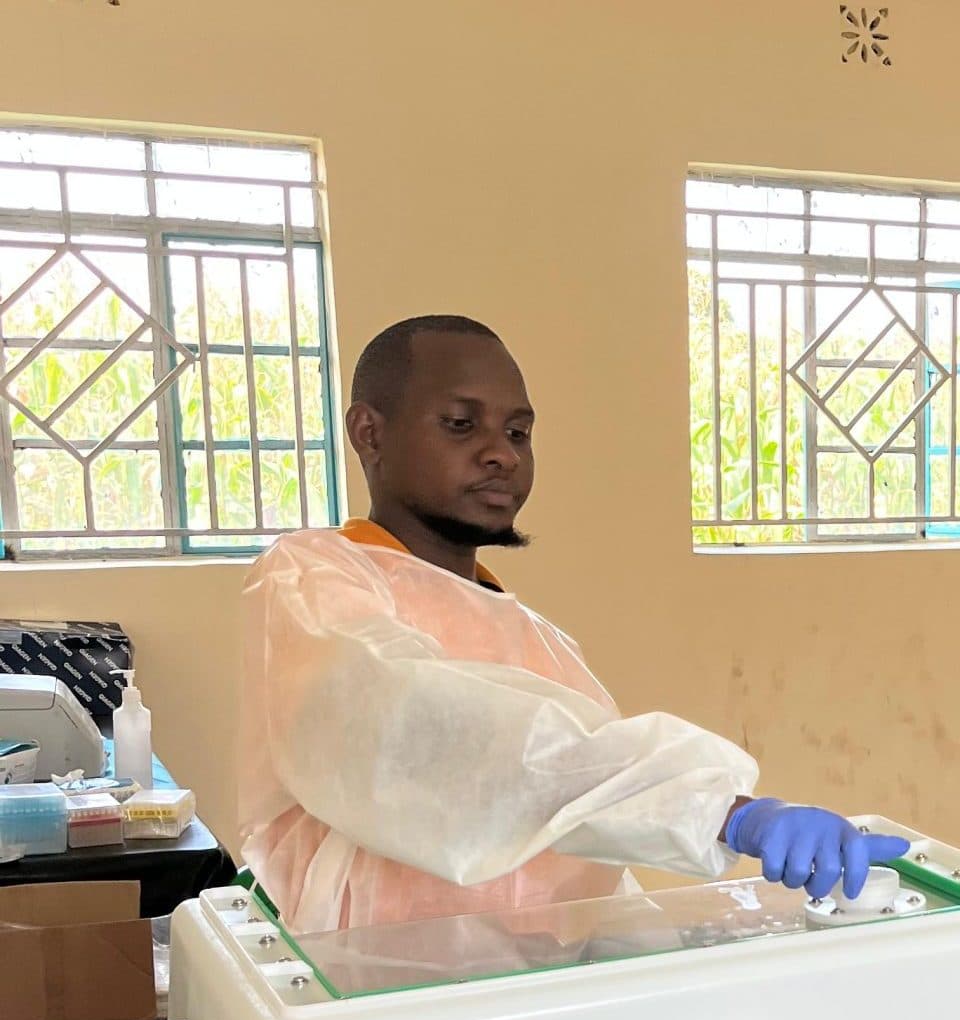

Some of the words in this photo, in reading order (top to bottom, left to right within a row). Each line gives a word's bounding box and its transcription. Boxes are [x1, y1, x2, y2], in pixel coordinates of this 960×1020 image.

[63, 662, 83, 680] QIAGEN
[89, 671, 108, 688] QIAGEN
[73, 685, 92, 702] QIAGEN
